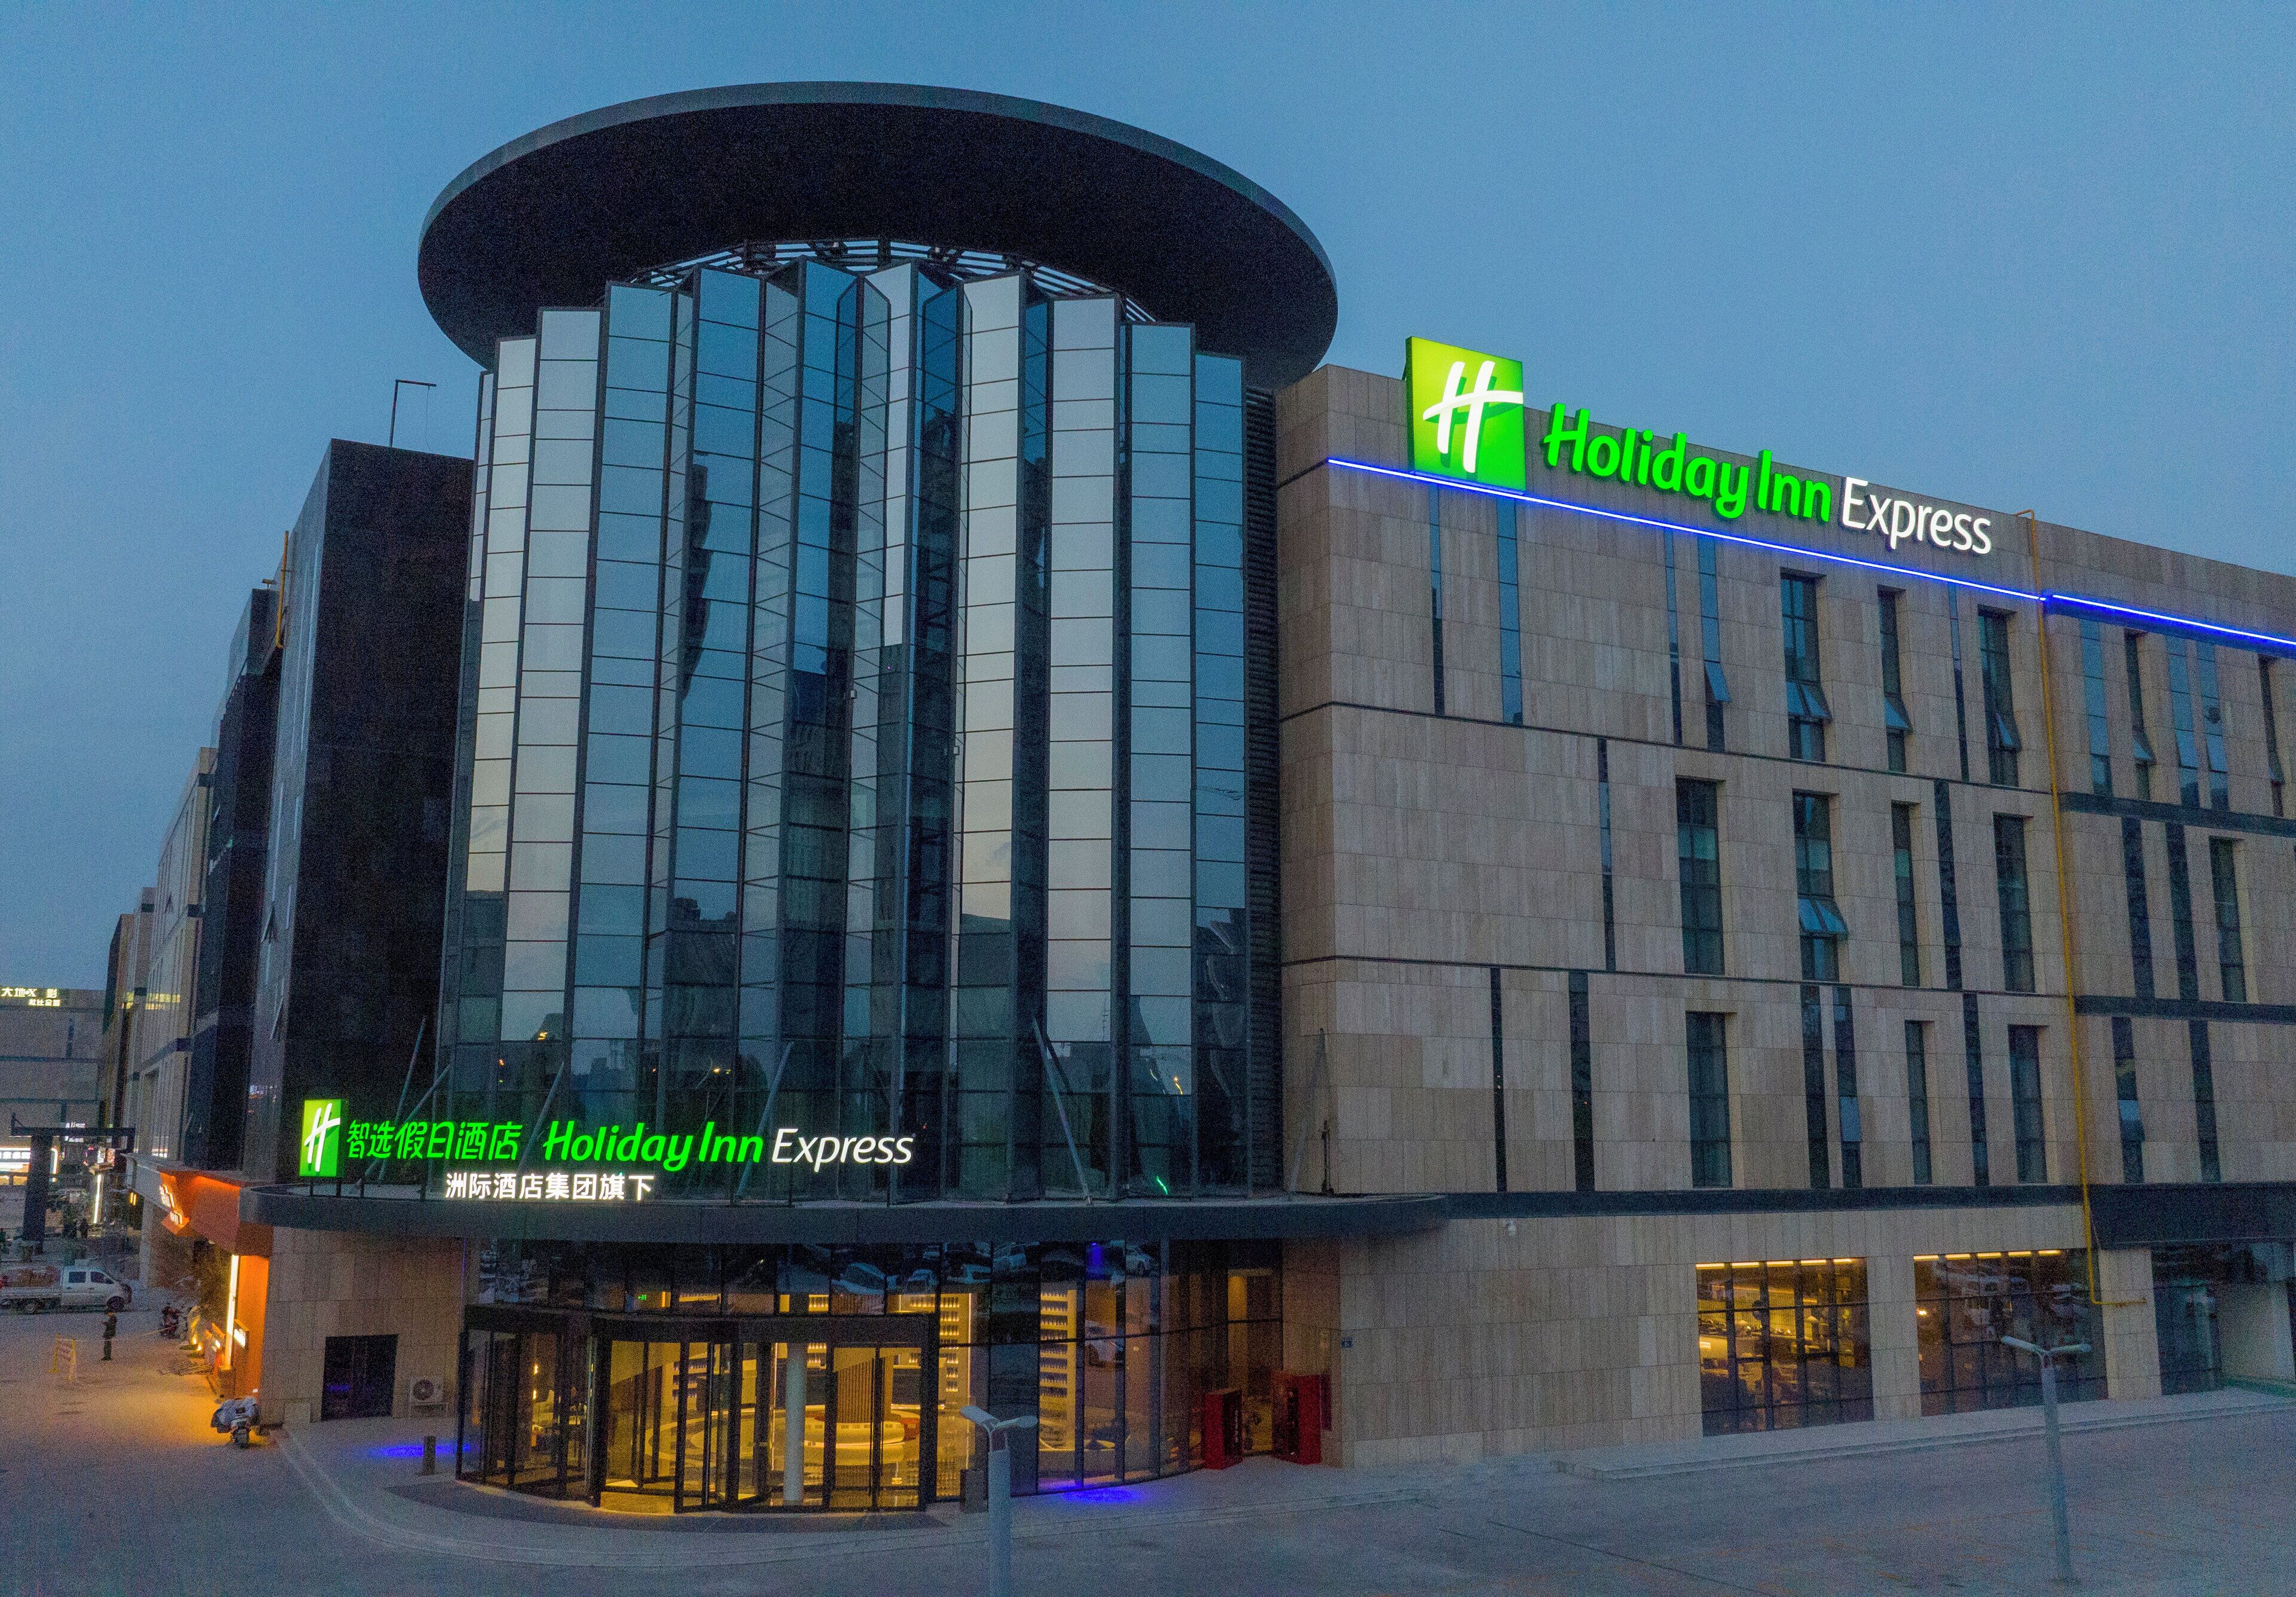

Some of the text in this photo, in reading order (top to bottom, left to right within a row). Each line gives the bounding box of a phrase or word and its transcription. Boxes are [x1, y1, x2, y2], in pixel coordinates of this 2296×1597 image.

[1543, 403, 1992, 554] Holiday Inn Express
[347, 1119, 523, 1161] 智选假日酒店
[542, 1120, 914, 1172] Holiday Inn Express
[445, 1172, 654, 1201] 洲际酒店集团旗下
